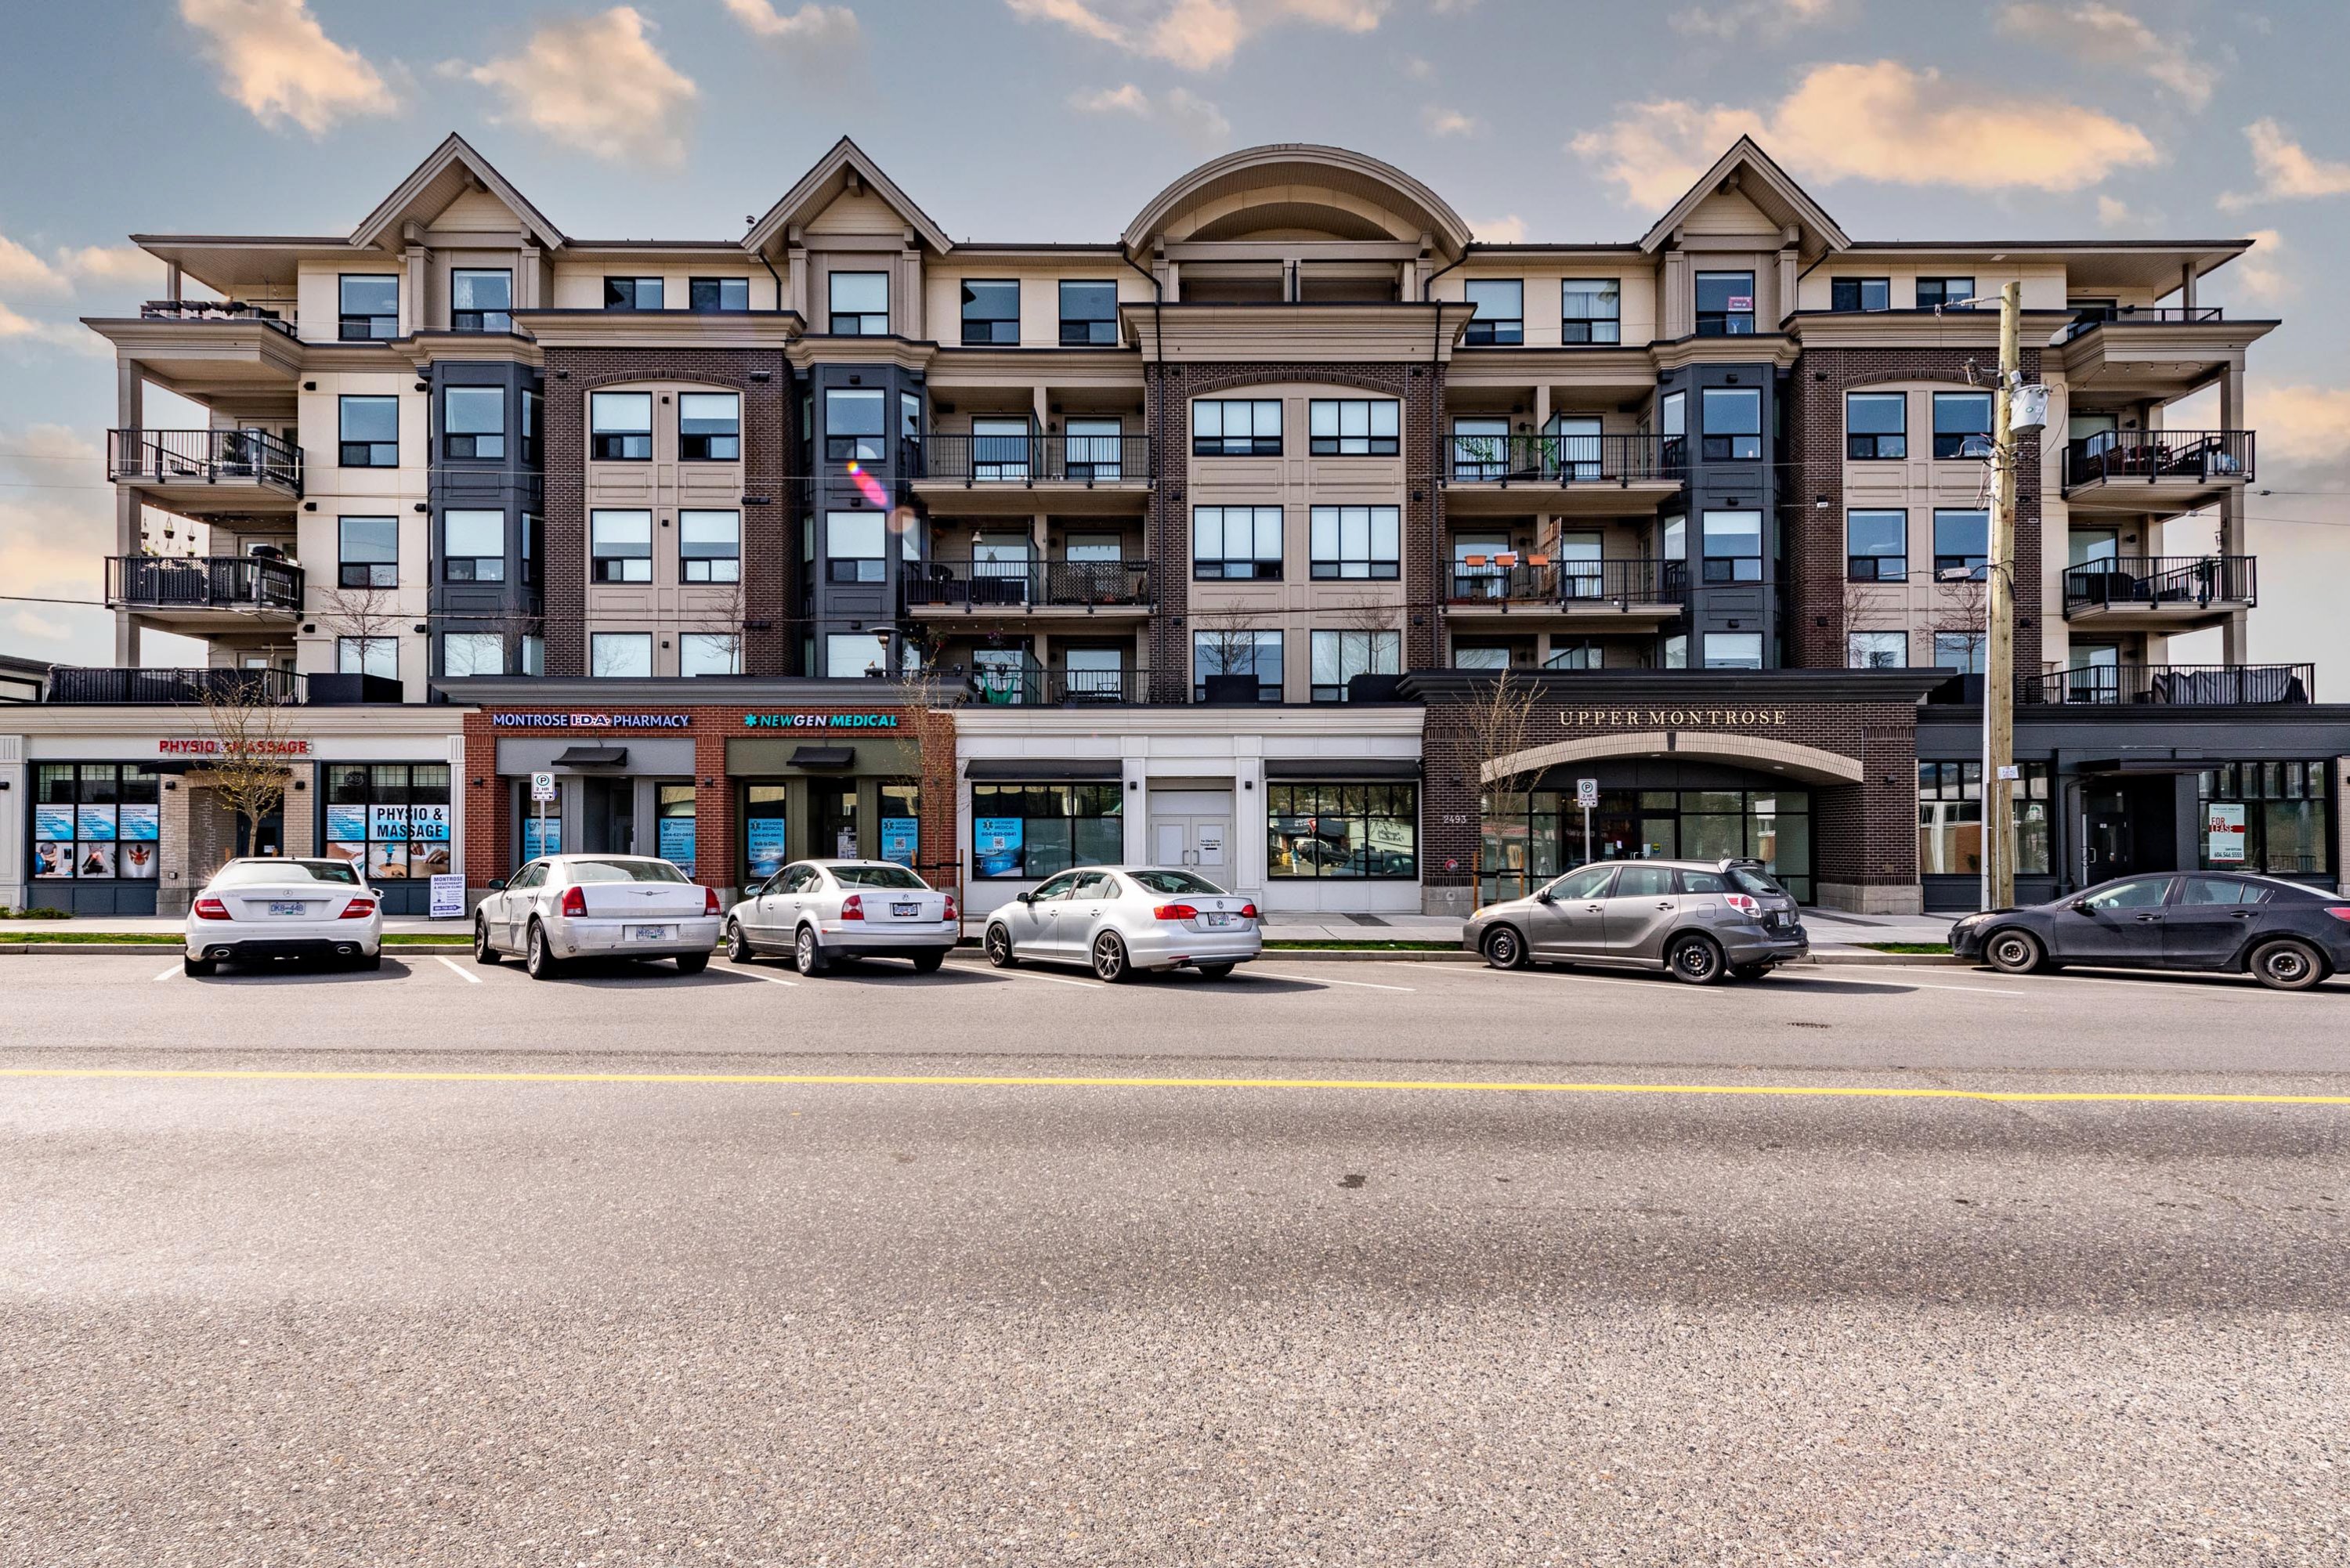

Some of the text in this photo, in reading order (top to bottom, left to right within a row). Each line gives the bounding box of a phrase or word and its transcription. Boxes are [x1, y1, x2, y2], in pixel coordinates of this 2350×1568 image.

[493, 714, 568, 727] MONTROSE
[613, 715, 689, 727] PHARMACY
[760, 714, 898, 727] NEWGEN MEDICAL
[1560, 710, 1786, 725] UPPER MONTROSE
[159, 740, 215, 753] PHYSIO
[377, 807, 443, 821] PHYSIO &
[1443, 815, 1466, 824] 2493
[2211, 817, 2225, 826] FOR
[377, 824, 443, 837] MASSAGE
[2211, 825, 2233, 833] LEASE
